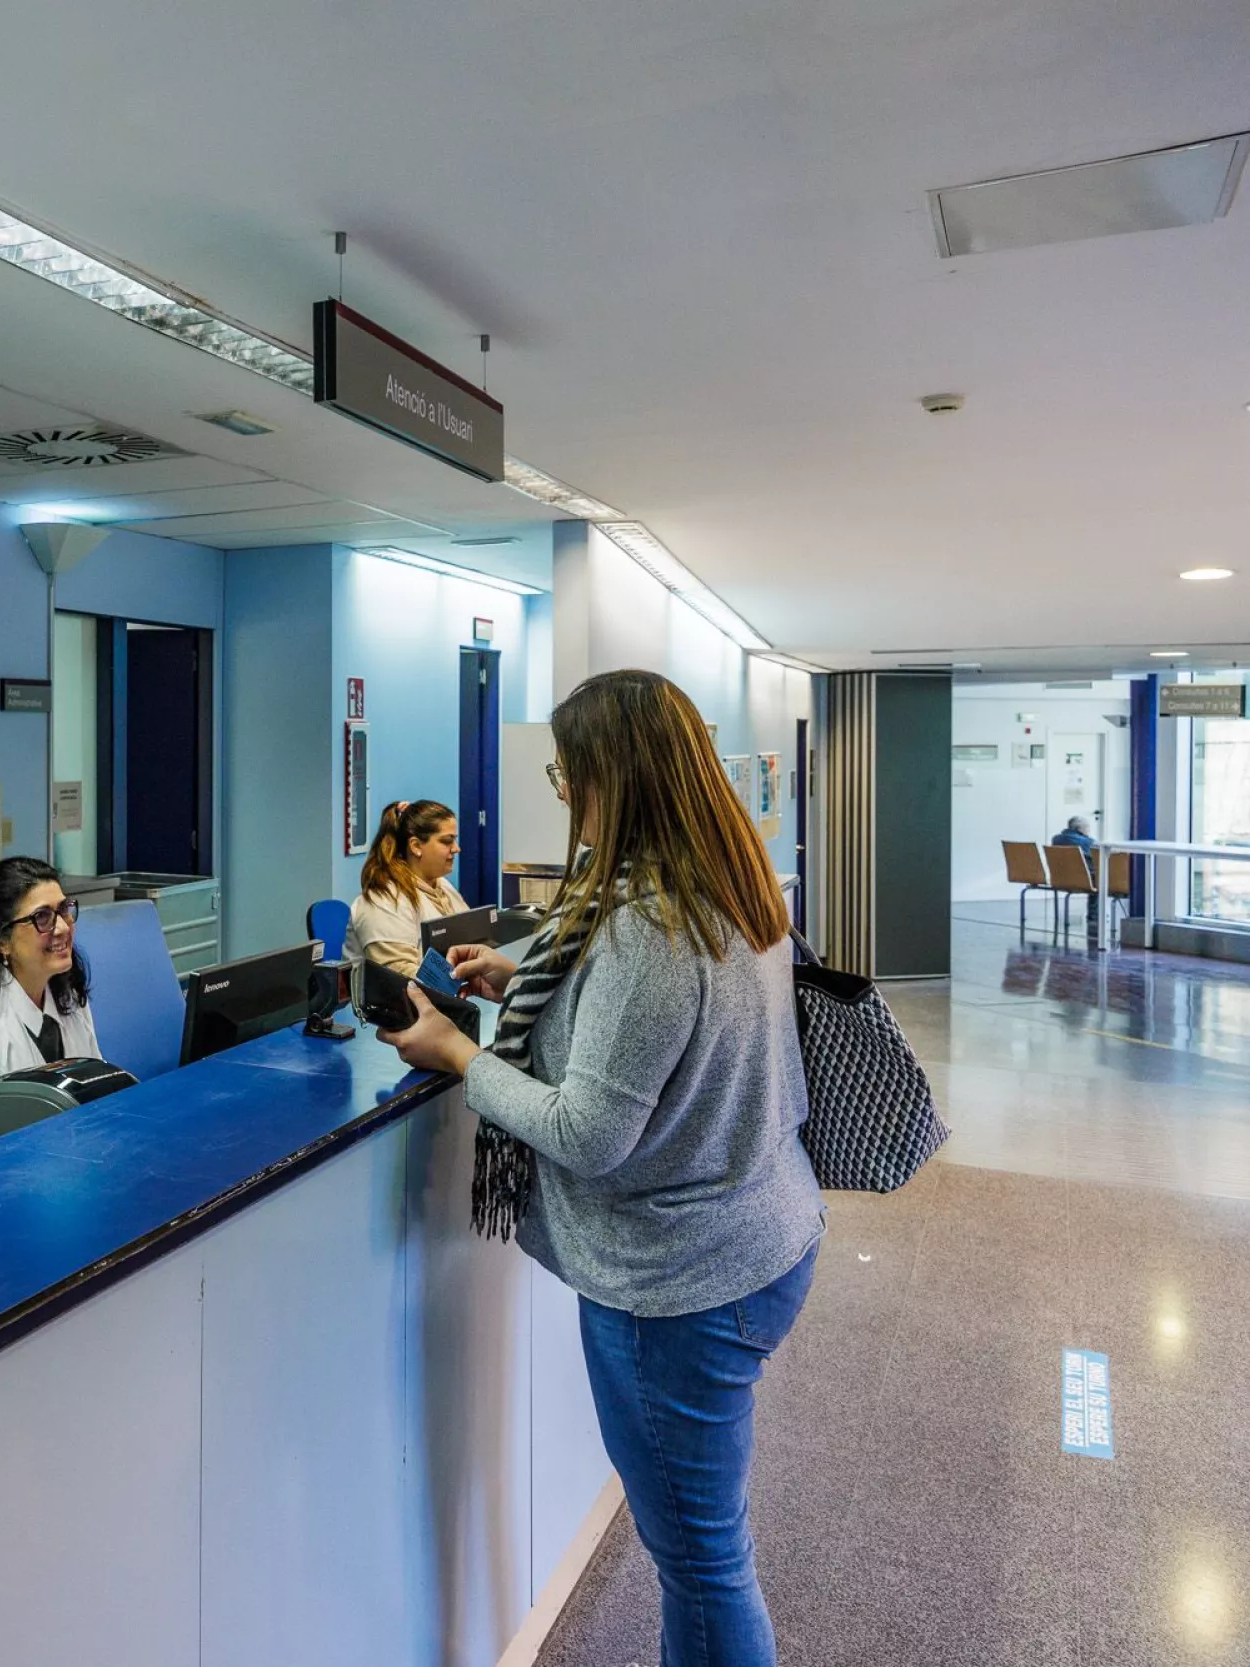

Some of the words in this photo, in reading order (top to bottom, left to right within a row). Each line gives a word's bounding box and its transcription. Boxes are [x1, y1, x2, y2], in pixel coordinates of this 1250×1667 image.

[385, 373, 427, 419] Atenció
[429, 403, 436, 424] a
[437, 402, 473, 443] l'Usuari
[203, 979, 230, 994] lenovo
